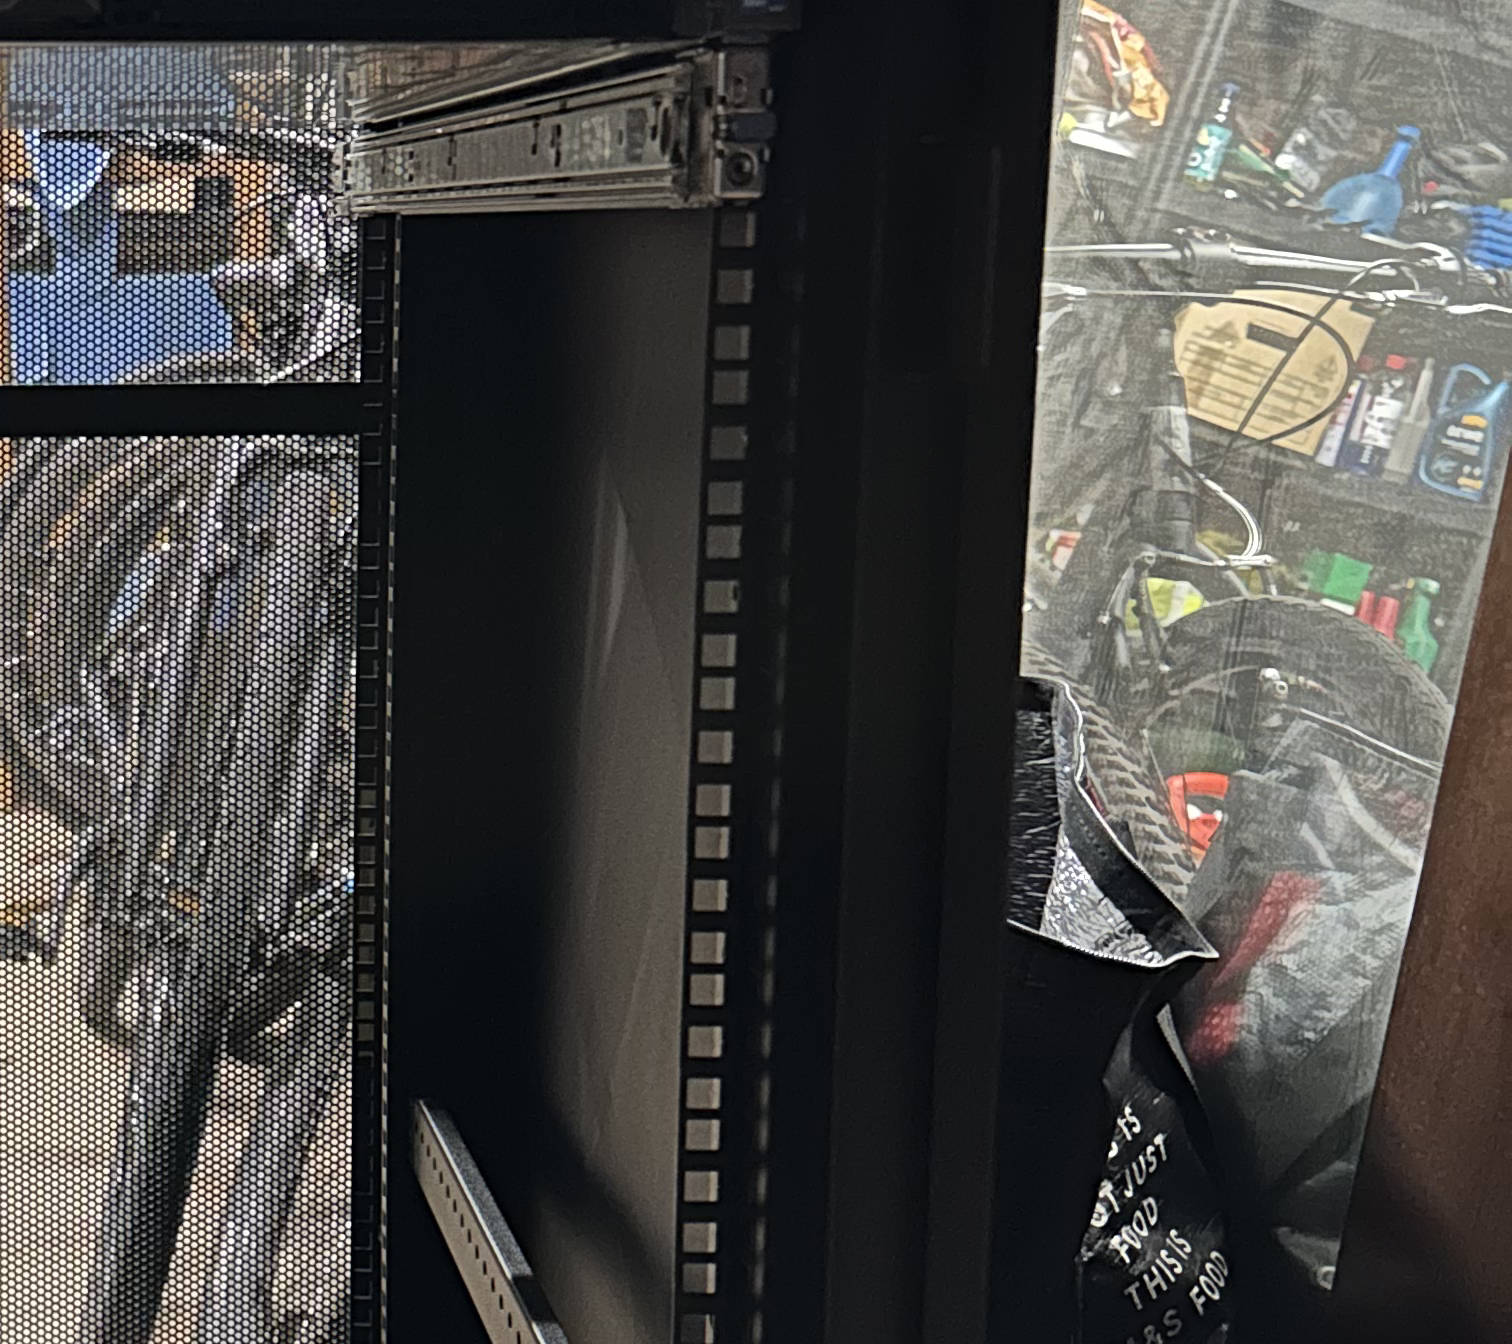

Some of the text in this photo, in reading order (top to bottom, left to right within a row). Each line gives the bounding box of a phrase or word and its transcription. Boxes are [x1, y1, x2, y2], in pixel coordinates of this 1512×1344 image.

[1123, 1132, 1169, 1199] JUST
[1109, 1195, 1160, 1265] FOOD
[1123, 1227, 1193, 1312] THIS IS
[1189, 1249, 1231, 1317] FOOD
